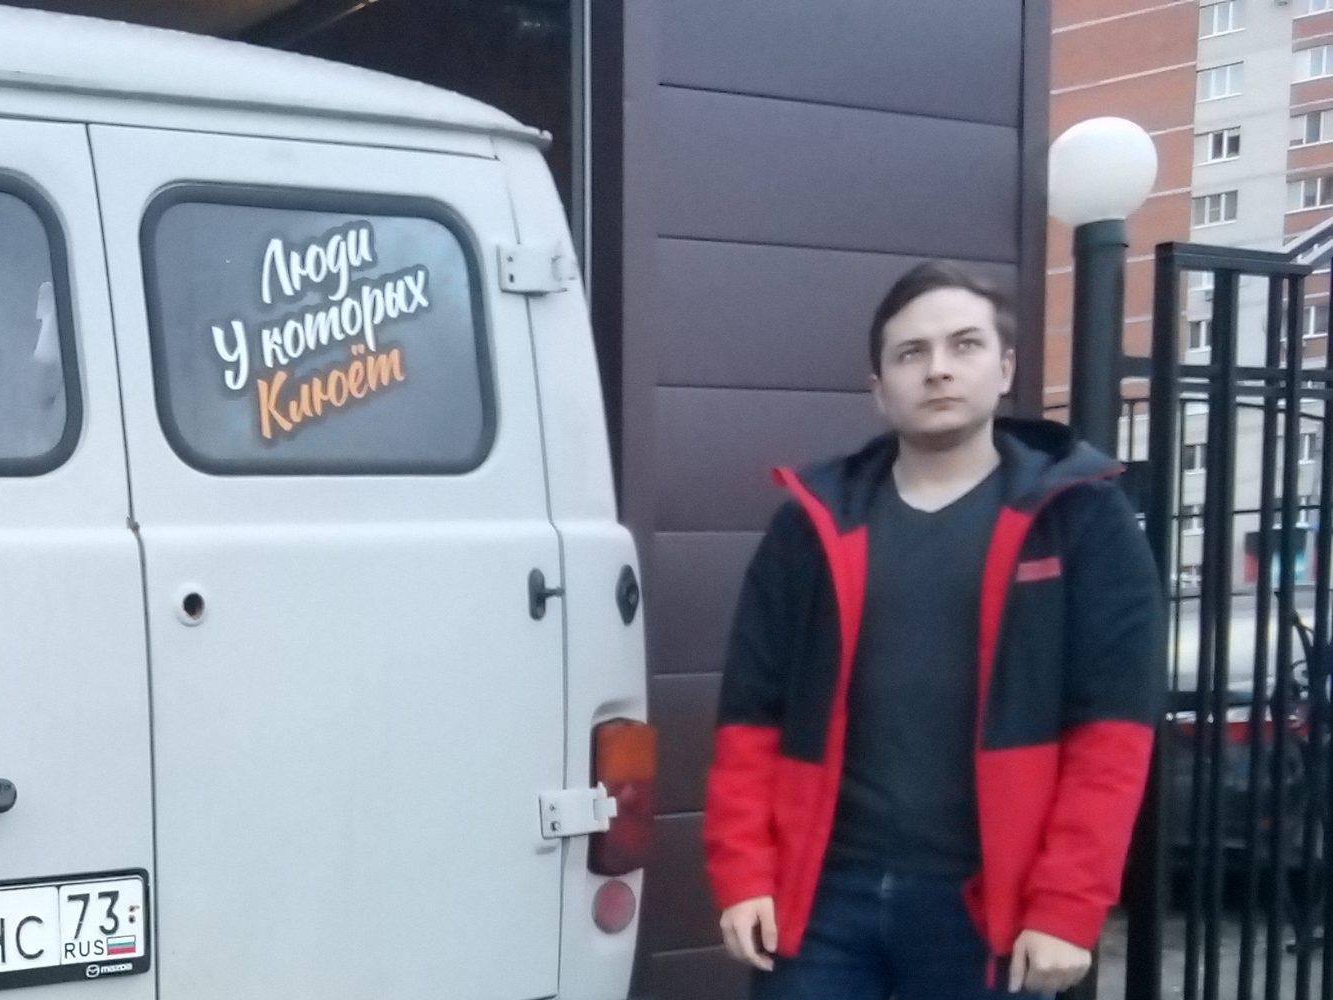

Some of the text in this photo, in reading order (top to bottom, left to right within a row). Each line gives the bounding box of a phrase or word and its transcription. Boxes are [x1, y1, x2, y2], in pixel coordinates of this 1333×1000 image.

[261, 228, 373, 304] Люди
[261, 270, 429, 368] которых
[257, 342, 405, 439] Клюёт
[64, 939, 105, 959] RUS
[67, 890, 120, 939] 73
